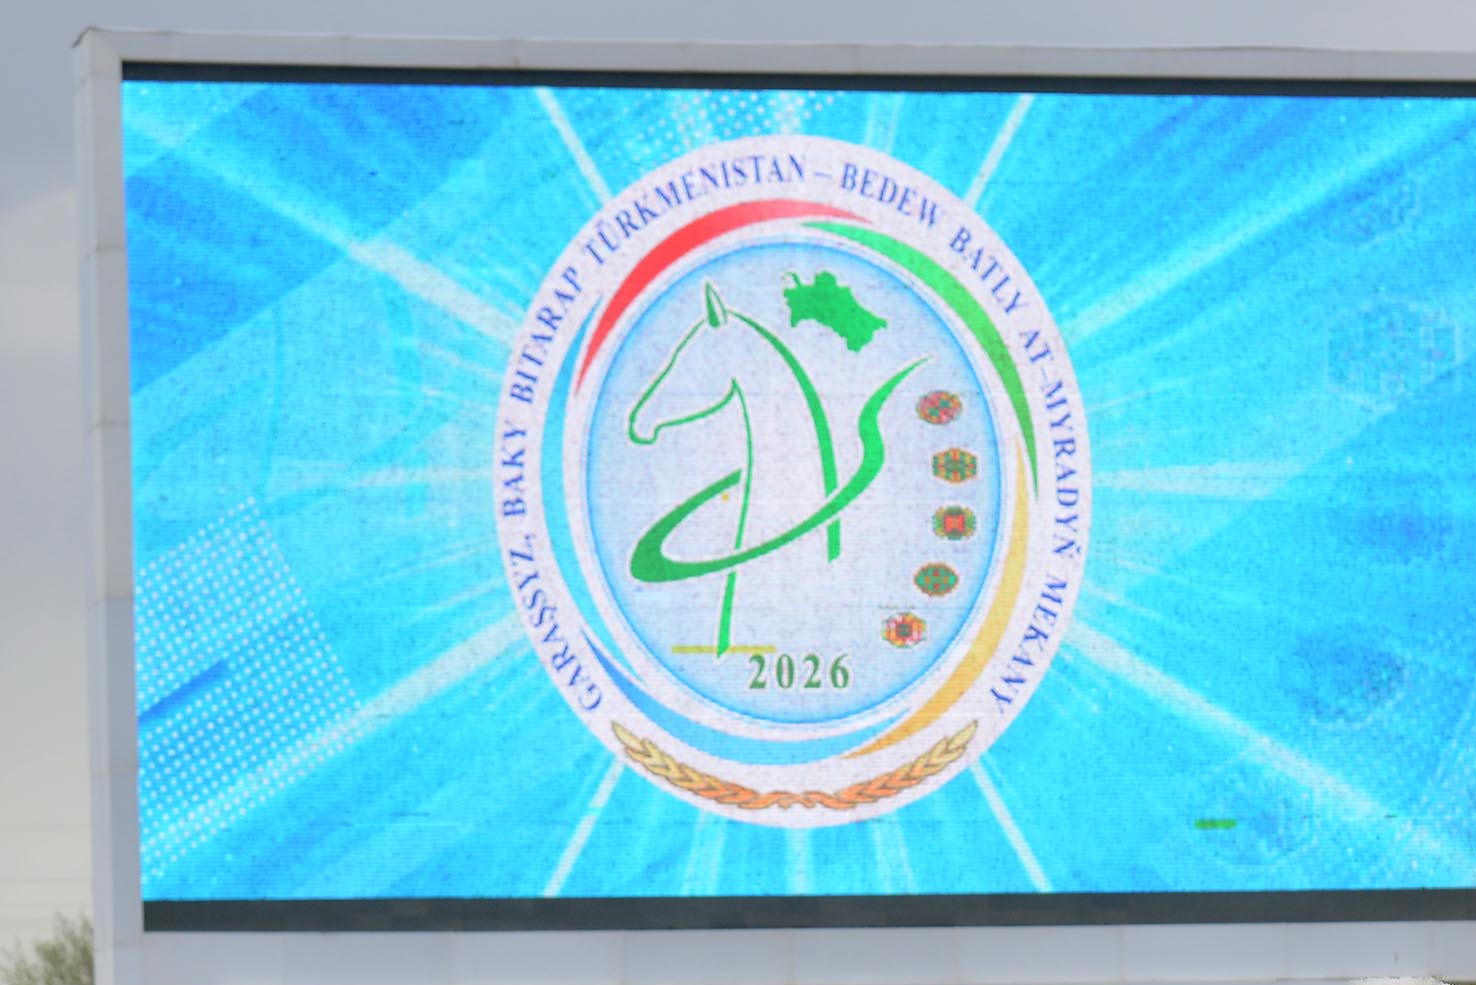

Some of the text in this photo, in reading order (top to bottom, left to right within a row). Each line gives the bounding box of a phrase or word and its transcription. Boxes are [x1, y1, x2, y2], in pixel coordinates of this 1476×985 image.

[582, 154, 804, 266] TÜRKMENISTAN
[840, 162, 946, 229] BEDEW
[950, 226, 1028, 315] BATLY
[510, 266, 582, 404] BITARAP
[502, 420, 527, 517] BAKY
[748, 652, 850, 689] 2026
[990, 573, 1067, 714] MEKANY
